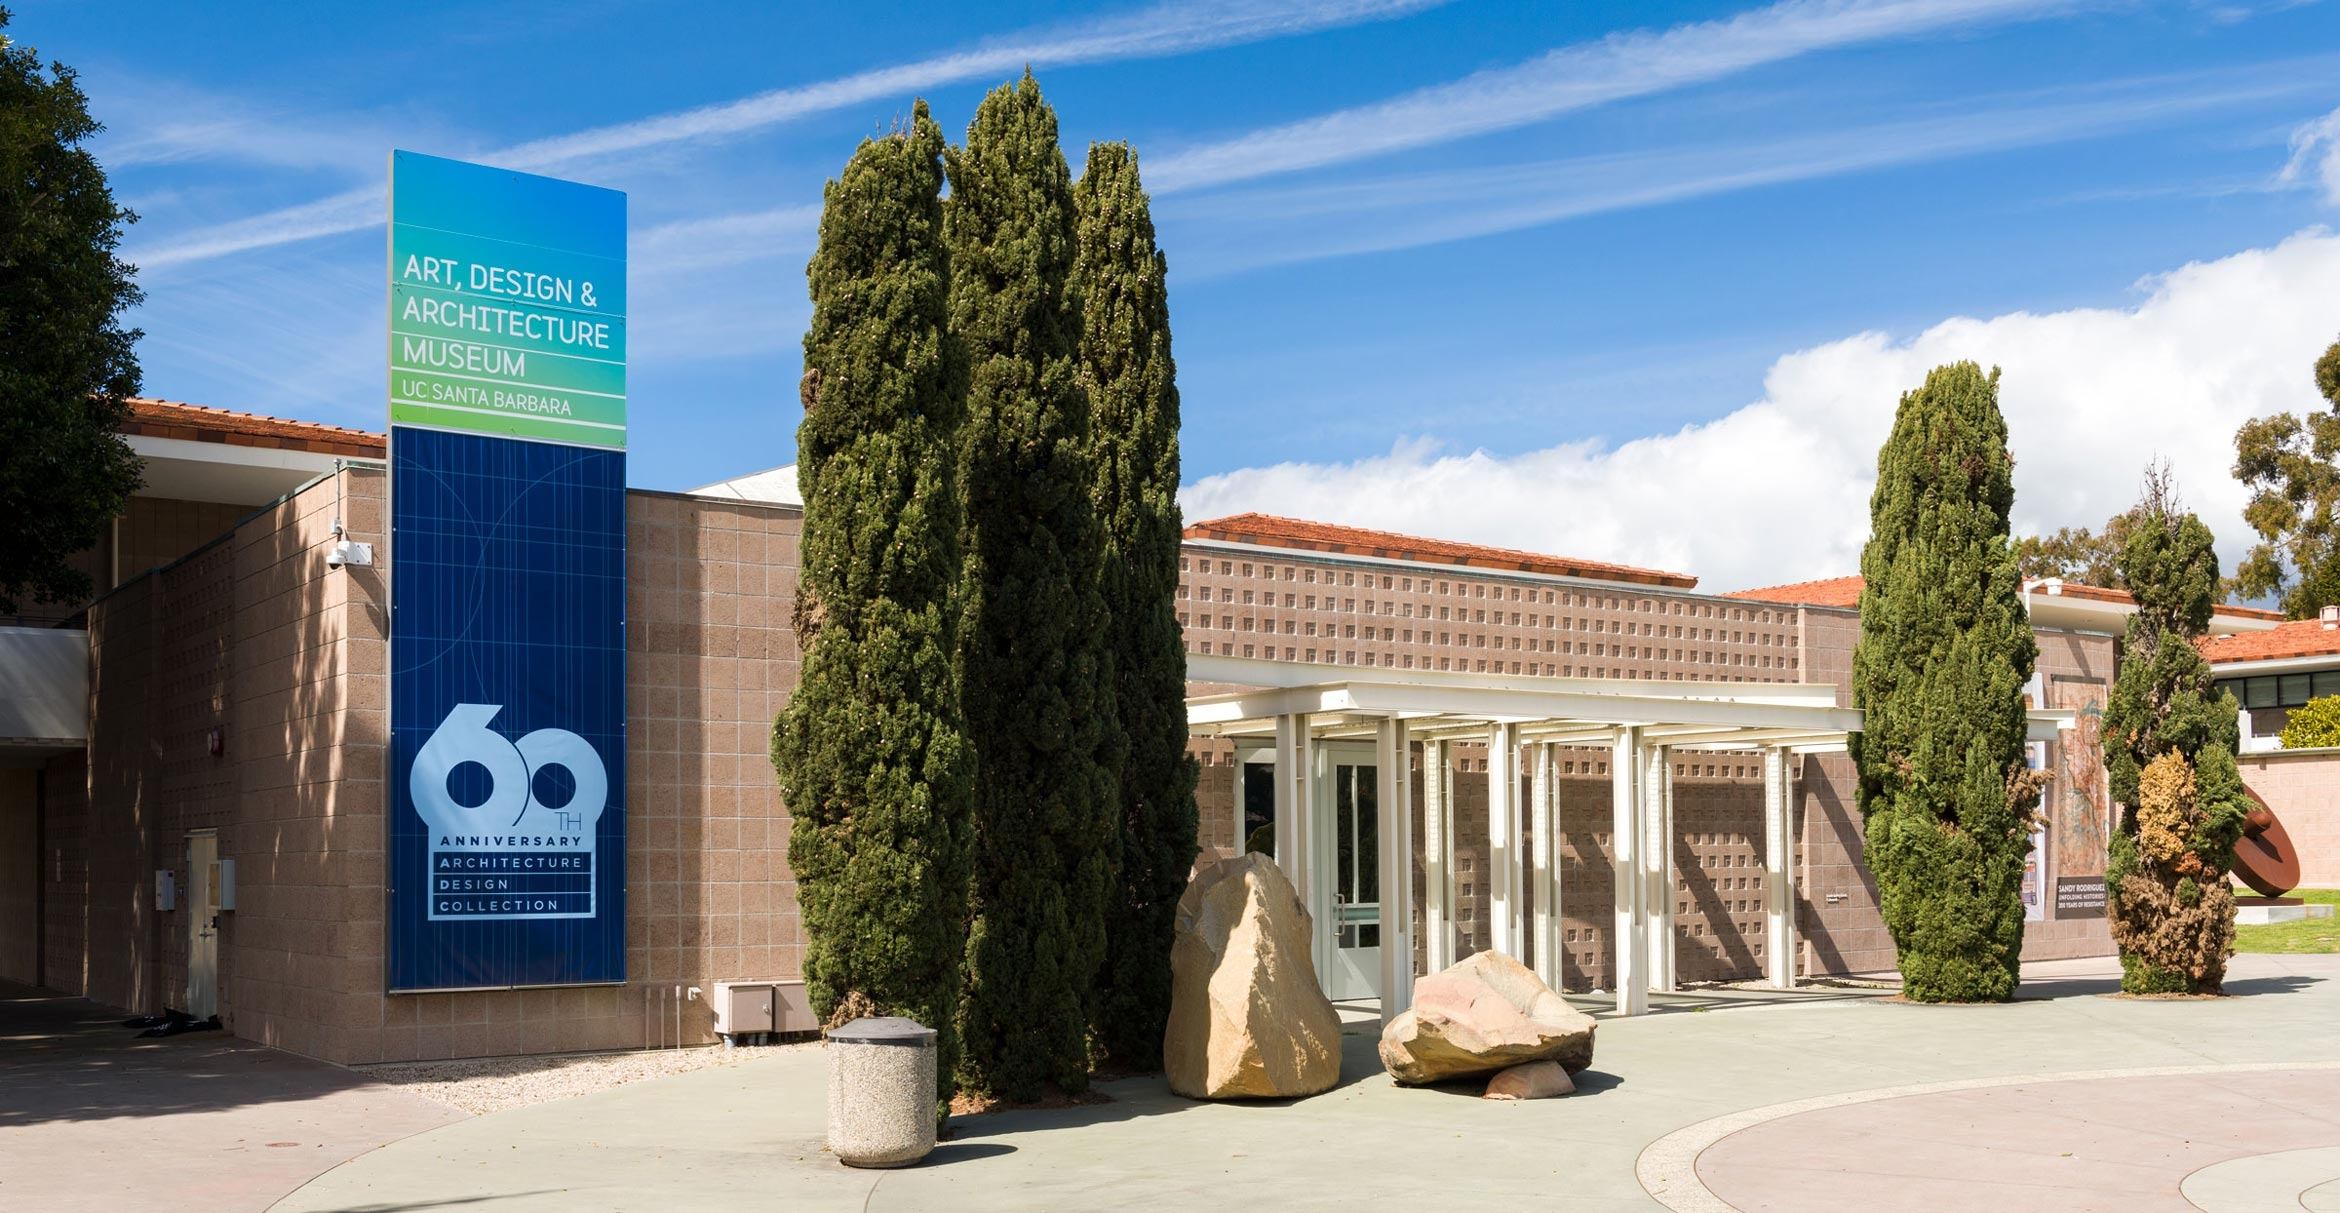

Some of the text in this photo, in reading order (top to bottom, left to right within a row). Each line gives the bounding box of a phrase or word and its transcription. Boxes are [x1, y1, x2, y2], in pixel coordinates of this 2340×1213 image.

[403, 254, 598, 308] ART, DESIGN &
[403, 296, 610, 349] ARCHITECTURE
[403, 336, 525, 378] MUSEUM
[402, 379, 572, 416] UC SANTA BARBARA
[440, 836, 582, 847] ANNIVERSARY
[440, 857, 582, 869] ARCHITECTURE
[440, 879, 508, 890] DESIGN
[2058, 884, 2105, 893] SANDY RODRIGUEZ
[440, 900, 557, 912] COLLECTION
